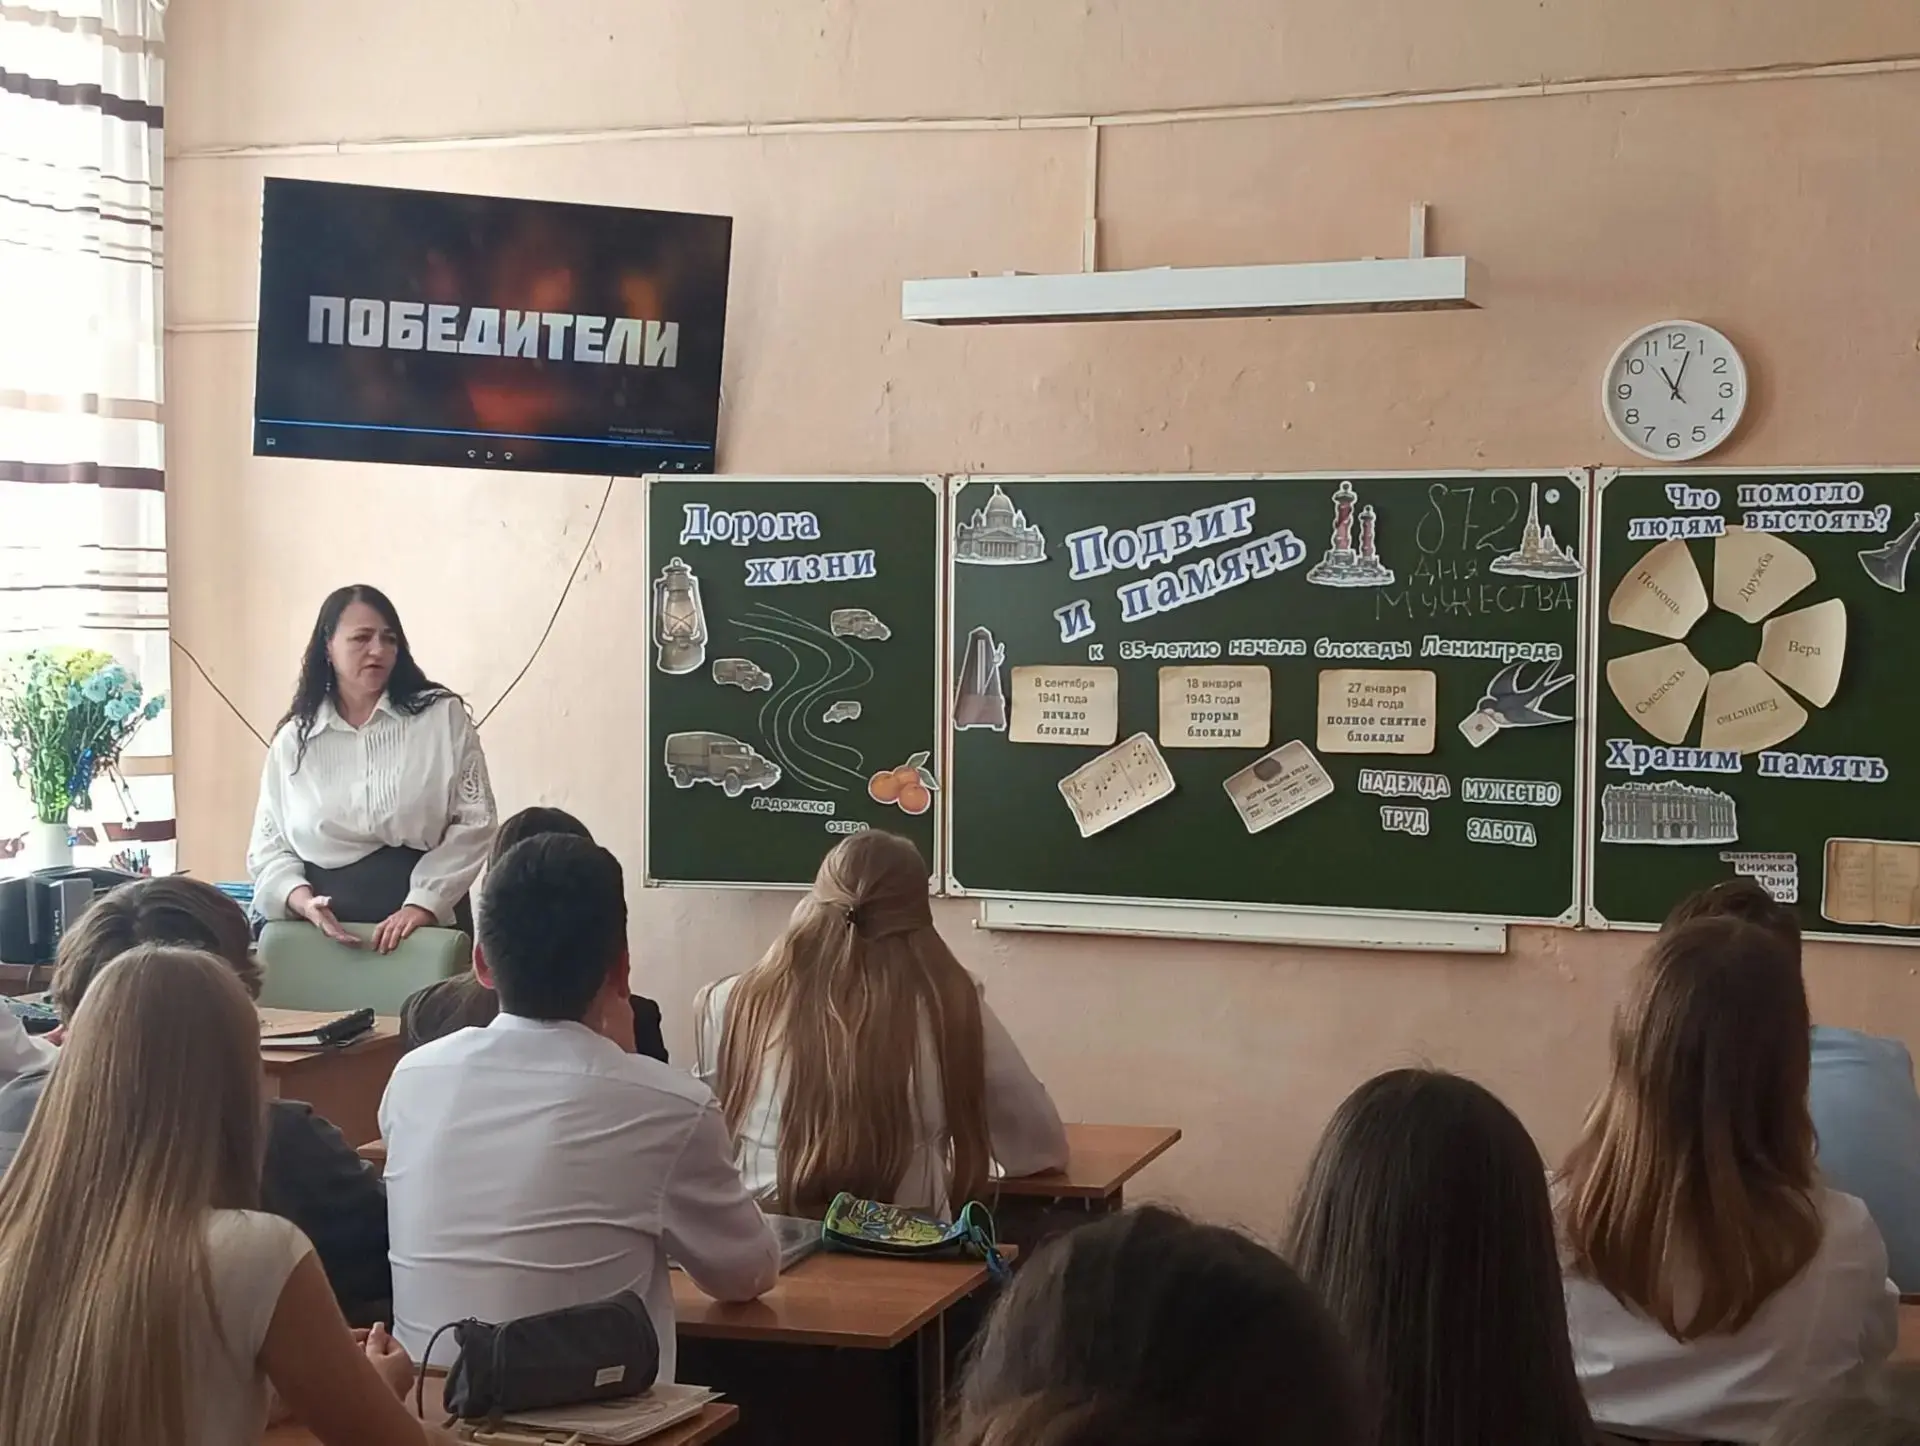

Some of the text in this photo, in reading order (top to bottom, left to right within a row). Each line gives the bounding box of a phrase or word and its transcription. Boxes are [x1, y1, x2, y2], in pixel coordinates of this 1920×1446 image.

[308, 295, 679, 367] ПОБЕДИТЕЛИ
[1644, 340, 1658, 356] 11
[1667, 333, 1686, 350] 12
[1698, 339, 1704, 355] 1
[1625, 358, 1645, 375] 10
[1712, 357, 1727, 374] 2
[1617, 384, 1632, 400] 9
[1718, 382, 1734, 399] 3
[1625, 408, 1640, 424] 8
[1711, 408, 1725, 424] 4
[1643, 426, 1656, 443] 7
[1666, 432, 1681, 449] 6
[1691, 426, 1706, 442] 5
[1666, 483, 1862, 508] Что помогло
[682, 504, 819, 543] Дорога
[1416, 483, 1519, 554] 872
[1629, 506, 1890, 540] людям выстоять?
[1069, 499, 1253, 578] Подвиг
[746, 552, 875, 584] жизни
[1738, 552, 1774, 602] Дружба
[1056, 532, 1304, 640] и память
[1637, 571, 1682, 615] Помощь
[1376, 581, 1573, 620] МУЖЕСТВА
[1090, 635, 1561, 661] к 85-летию начала блокады Ленинграда
[1788, 641, 1821, 657] Вера
[1034, 678, 1095, 690] 8 сентября
[1186, 678, 1243, 690] 18 января
[1347, 682, 1407, 695] 27 января
[1635, 669, 1685, 714] Смелость
[1038, 693, 1088, 705] 1941 года
[1185, 693, 1240, 706] 1943 года
[1346, 698, 1405, 710] 1944 года
[1042, 710, 1086, 721] начало
[1190, 710, 1239, 723] прорыв
[1327, 715, 1427, 727] полное снятие
[1036, 724, 1090, 737] блокады
[1187, 724, 1242, 738] блокады
[1347, 731, 1405, 743] блокады
[1607, 739, 1887, 781] Храним память
[1360, 770, 1450, 798] НАДЕЖДА
[1463, 779, 1560, 805] МУЖЕСТВО
[752, 797, 834, 814] ЛАДОЖСКОЕ
[1381, 807, 1428, 834] ТРУД
[1468, 818, 1535, 845] ЗАБОТА
[1738, 863, 1795, 873] книжка
[1759, 875, 1795, 886] Тани
